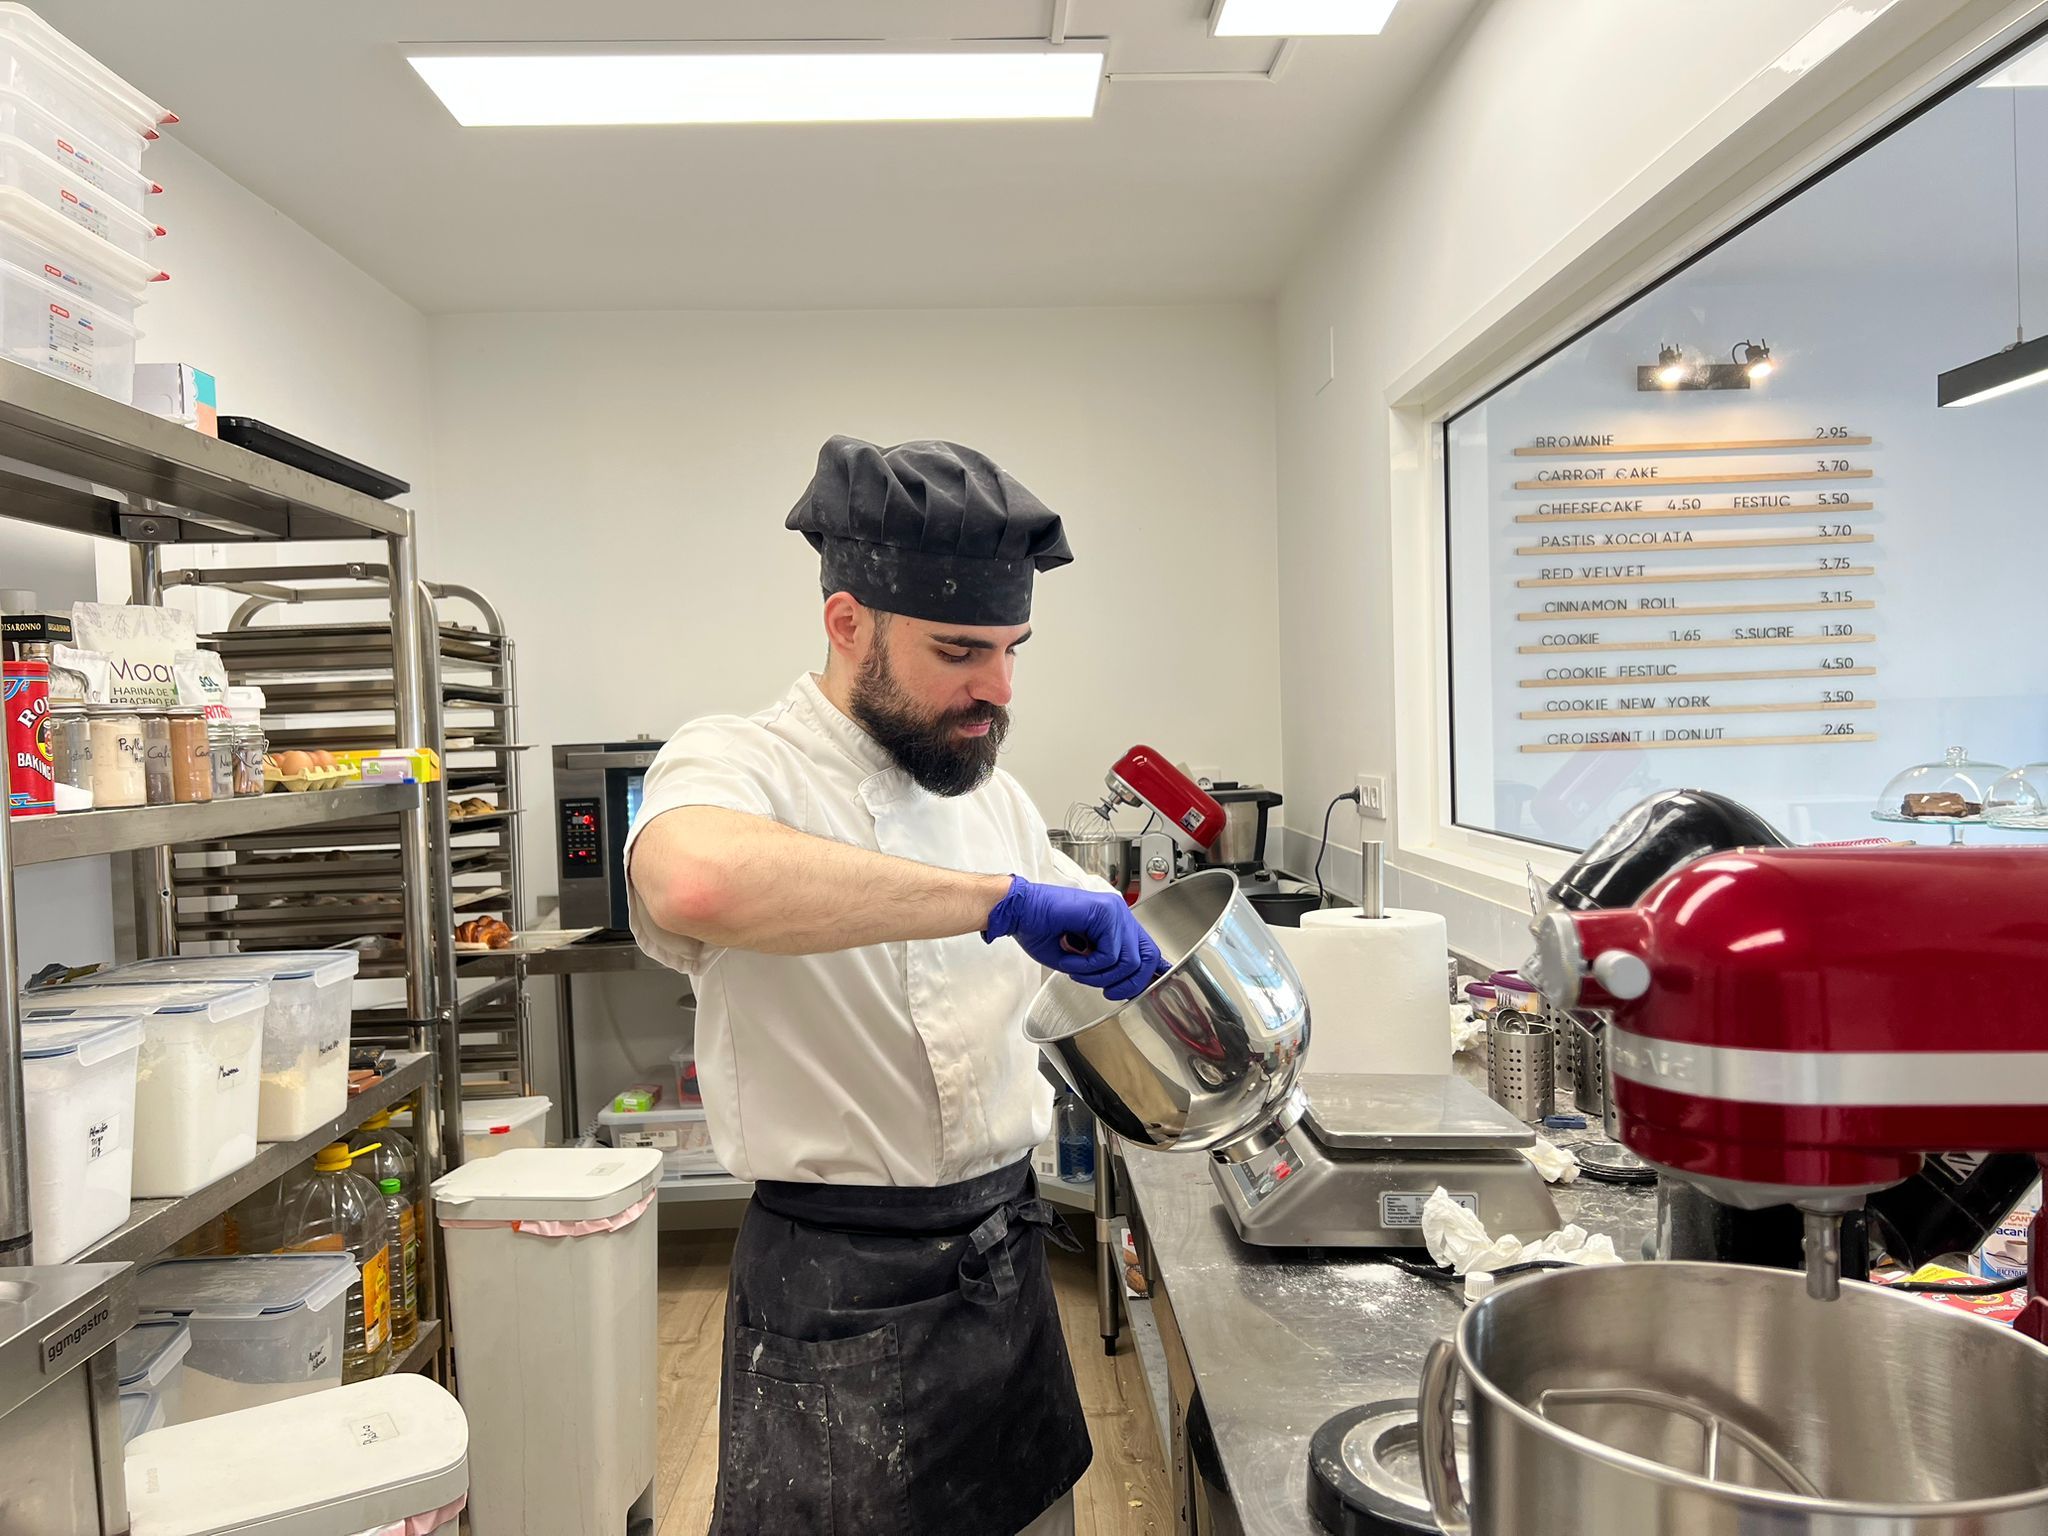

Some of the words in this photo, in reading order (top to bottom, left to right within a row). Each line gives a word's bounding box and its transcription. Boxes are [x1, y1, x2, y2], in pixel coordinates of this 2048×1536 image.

[1536, 434, 1614, 448] BROWNIE
[1816, 426, 1848, 439] 2.95
[1538, 468, 1606, 482] CARROT
[1616, 466, 1658, 480] CAKE
[1817, 459, 1849, 472] 3.70
[1538, 500, 1643, 515] CHEESECAKE
[1667, 498, 1701, 511] 4.50
[1733, 495, 1790, 508] FESTUC
[1818, 492, 1850, 505] 5.50
[1541, 534, 1595, 548] PASTIS
[1605, 531, 1693, 545] XOCOLATA
[1819, 524, 1852, 537] 3.70
[1541, 568, 1574, 580] RED
[1582, 564, 1646, 578] VELVET
[1820, 557, 1850, 570] 3.75
[1544, 599, 1627, 613] CINNAMON
[1641, 597, 1679, 610] ROLL
[1820, 590, 1853, 603] 3.15
[1541, 632, 1600, 646] COOKIE
[1672, 629, 1701, 642] 1.65
[1735, 626, 1794, 640] S.SUCRE
[1823, 624, 1853, 636] 1.30
[1546, 666, 1607, 680] COOKIE
[1619, 664, 1677, 677] FESTUC
[1822, 657, 1854, 669] 4.50
[113, 687, 155, 696] HARINA
[156, 688, 169, 697] DE
[1546, 698, 1608, 712] COOKIE
[1620, 697, 1656, 710] NEW
[1668, 695, 1711, 708] YORK
[1823, 690, 1854, 703] 3.50
[1547, 730, 1643, 745] CROISSANT
[1666, 727, 1724, 741] DONUT
[1824, 723, 1854, 736] 2.65
[1995, 1226, 2028, 1238] acari
[48, 1309, 109, 1362] ggmgastro
